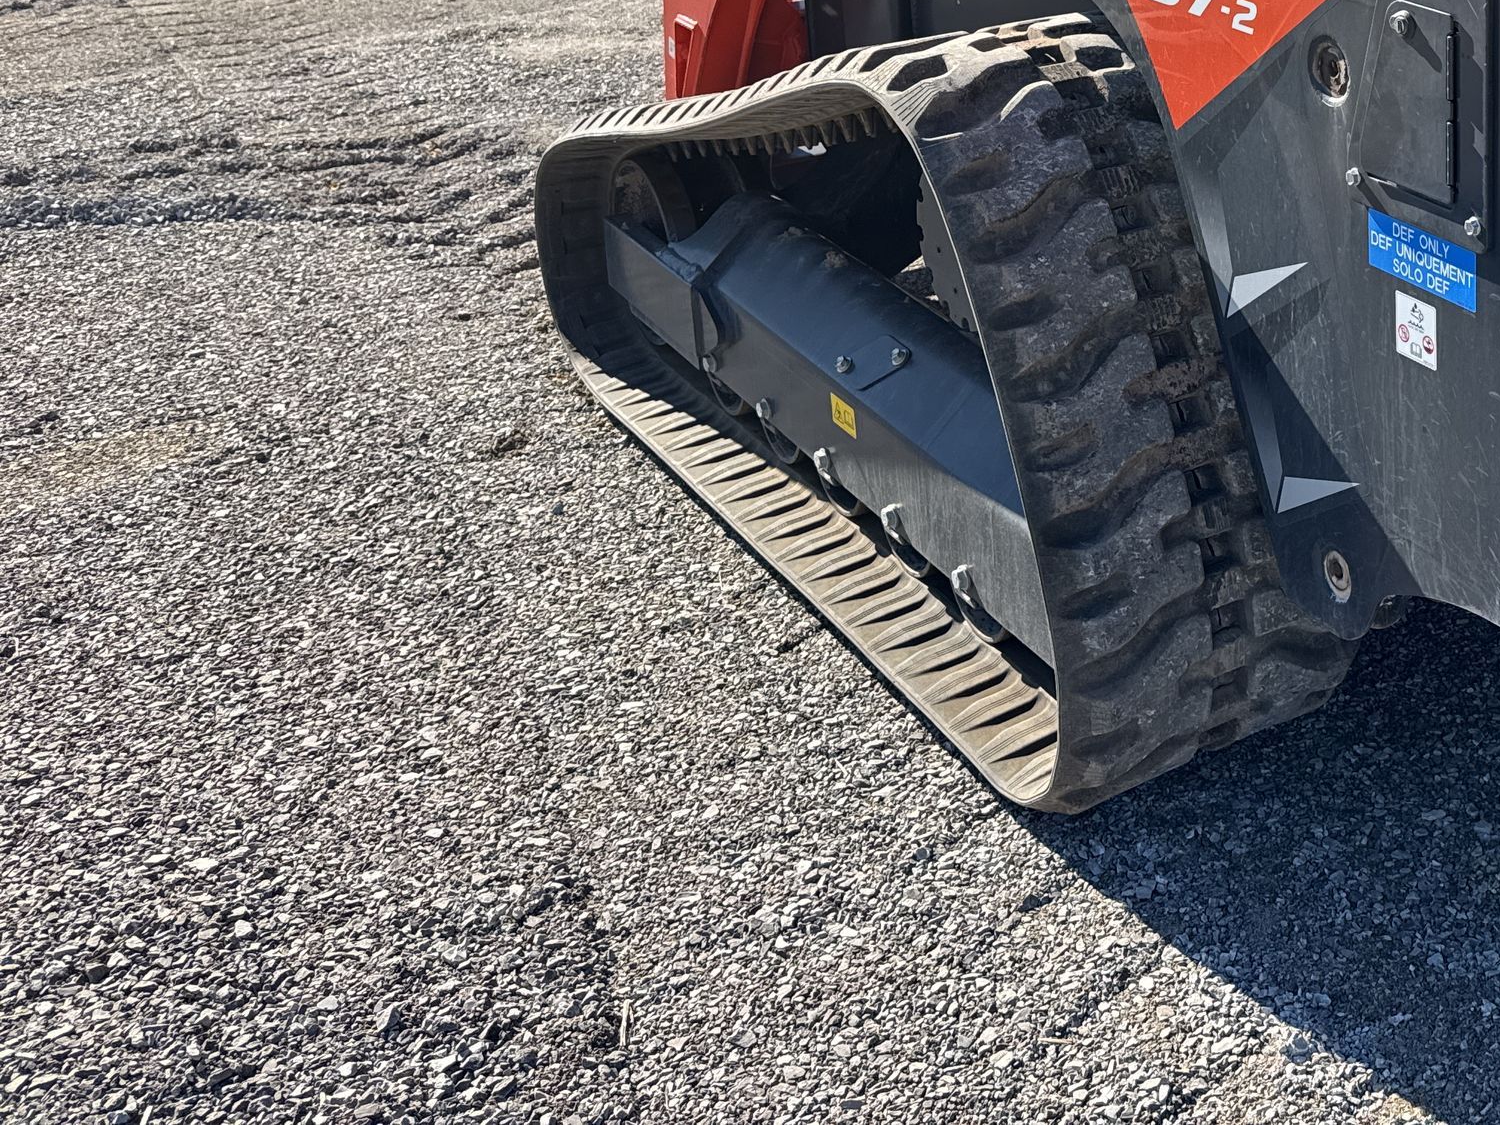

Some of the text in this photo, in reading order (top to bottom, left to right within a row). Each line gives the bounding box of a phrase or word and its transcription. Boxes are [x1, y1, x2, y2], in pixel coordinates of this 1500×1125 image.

[1392, 222, 1450, 259] DEF ONLY
[1370, 231, 1474, 289] DEF UNIQUEMENT
[1393, 259, 1450, 295] SOLO DEF
